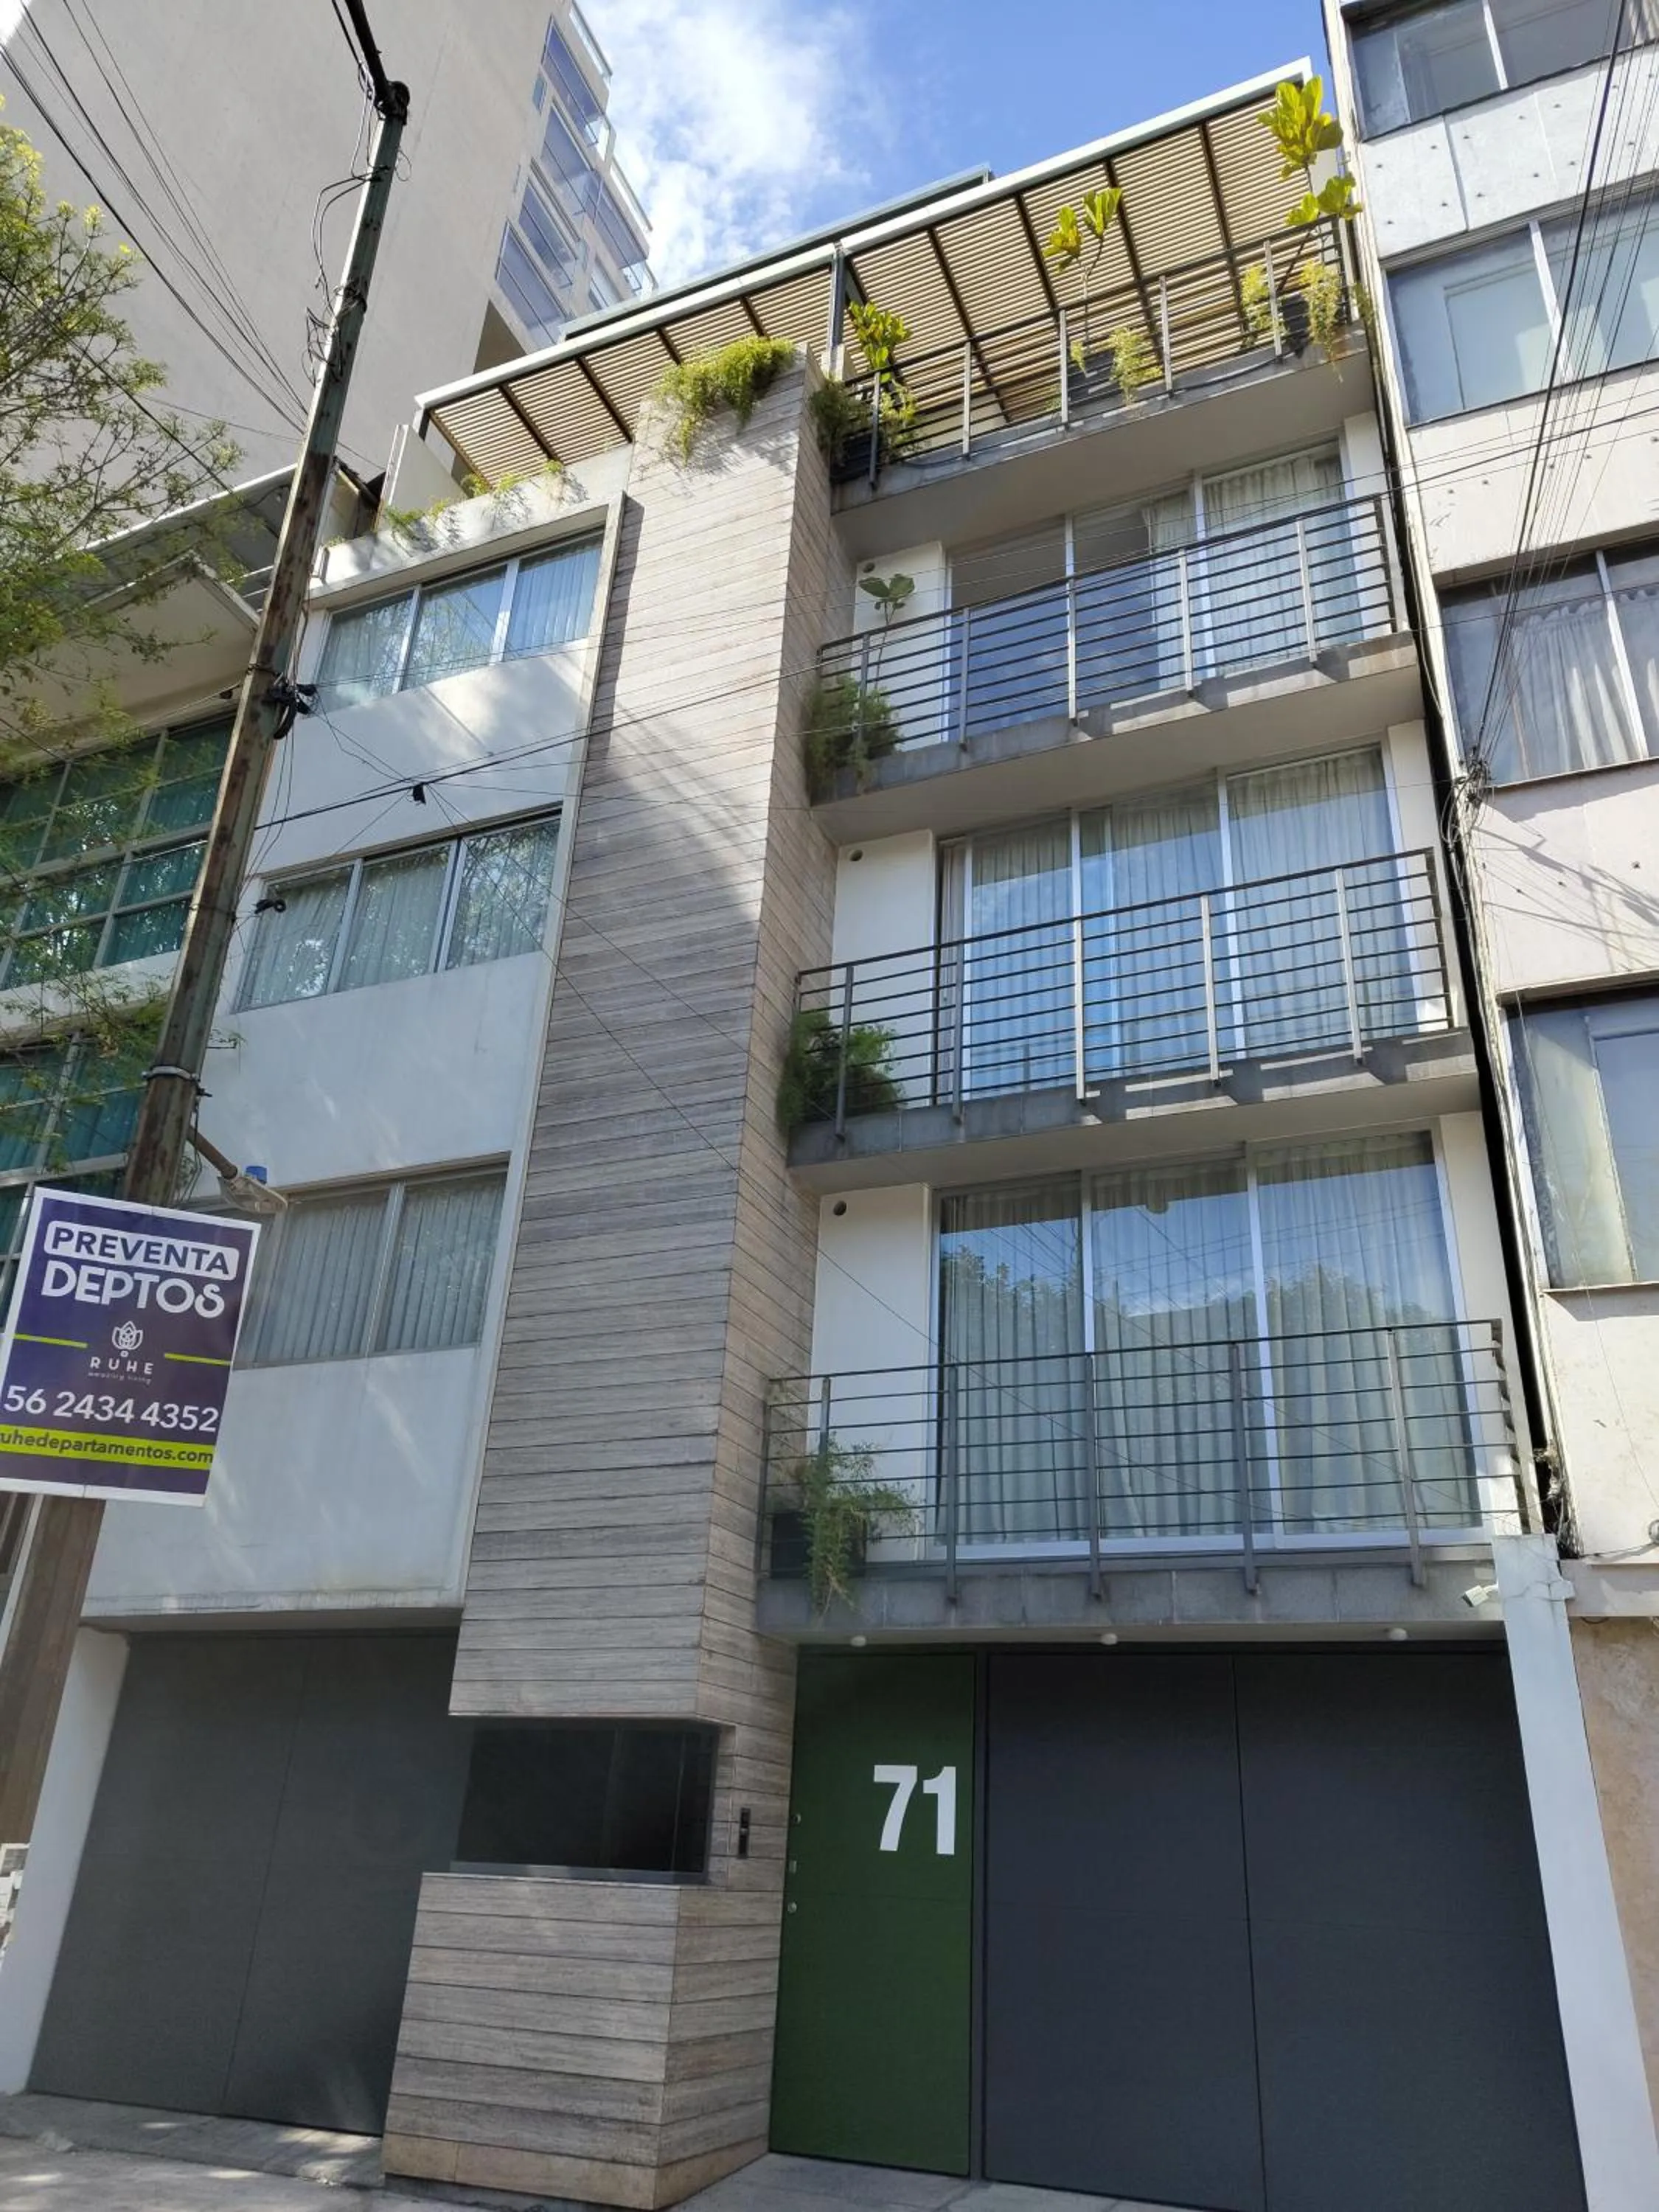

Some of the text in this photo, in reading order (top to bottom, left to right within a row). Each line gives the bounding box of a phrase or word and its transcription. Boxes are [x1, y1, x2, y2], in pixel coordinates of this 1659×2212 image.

[52, 1227, 230, 1275] PREVENTA
[41, 1261, 225, 1318] DEPTOS
[90, 1357, 154, 1374] RUHE
[4, 1385, 219, 1432] 56 2434 4352
[873, 1764, 956, 1855] 71
